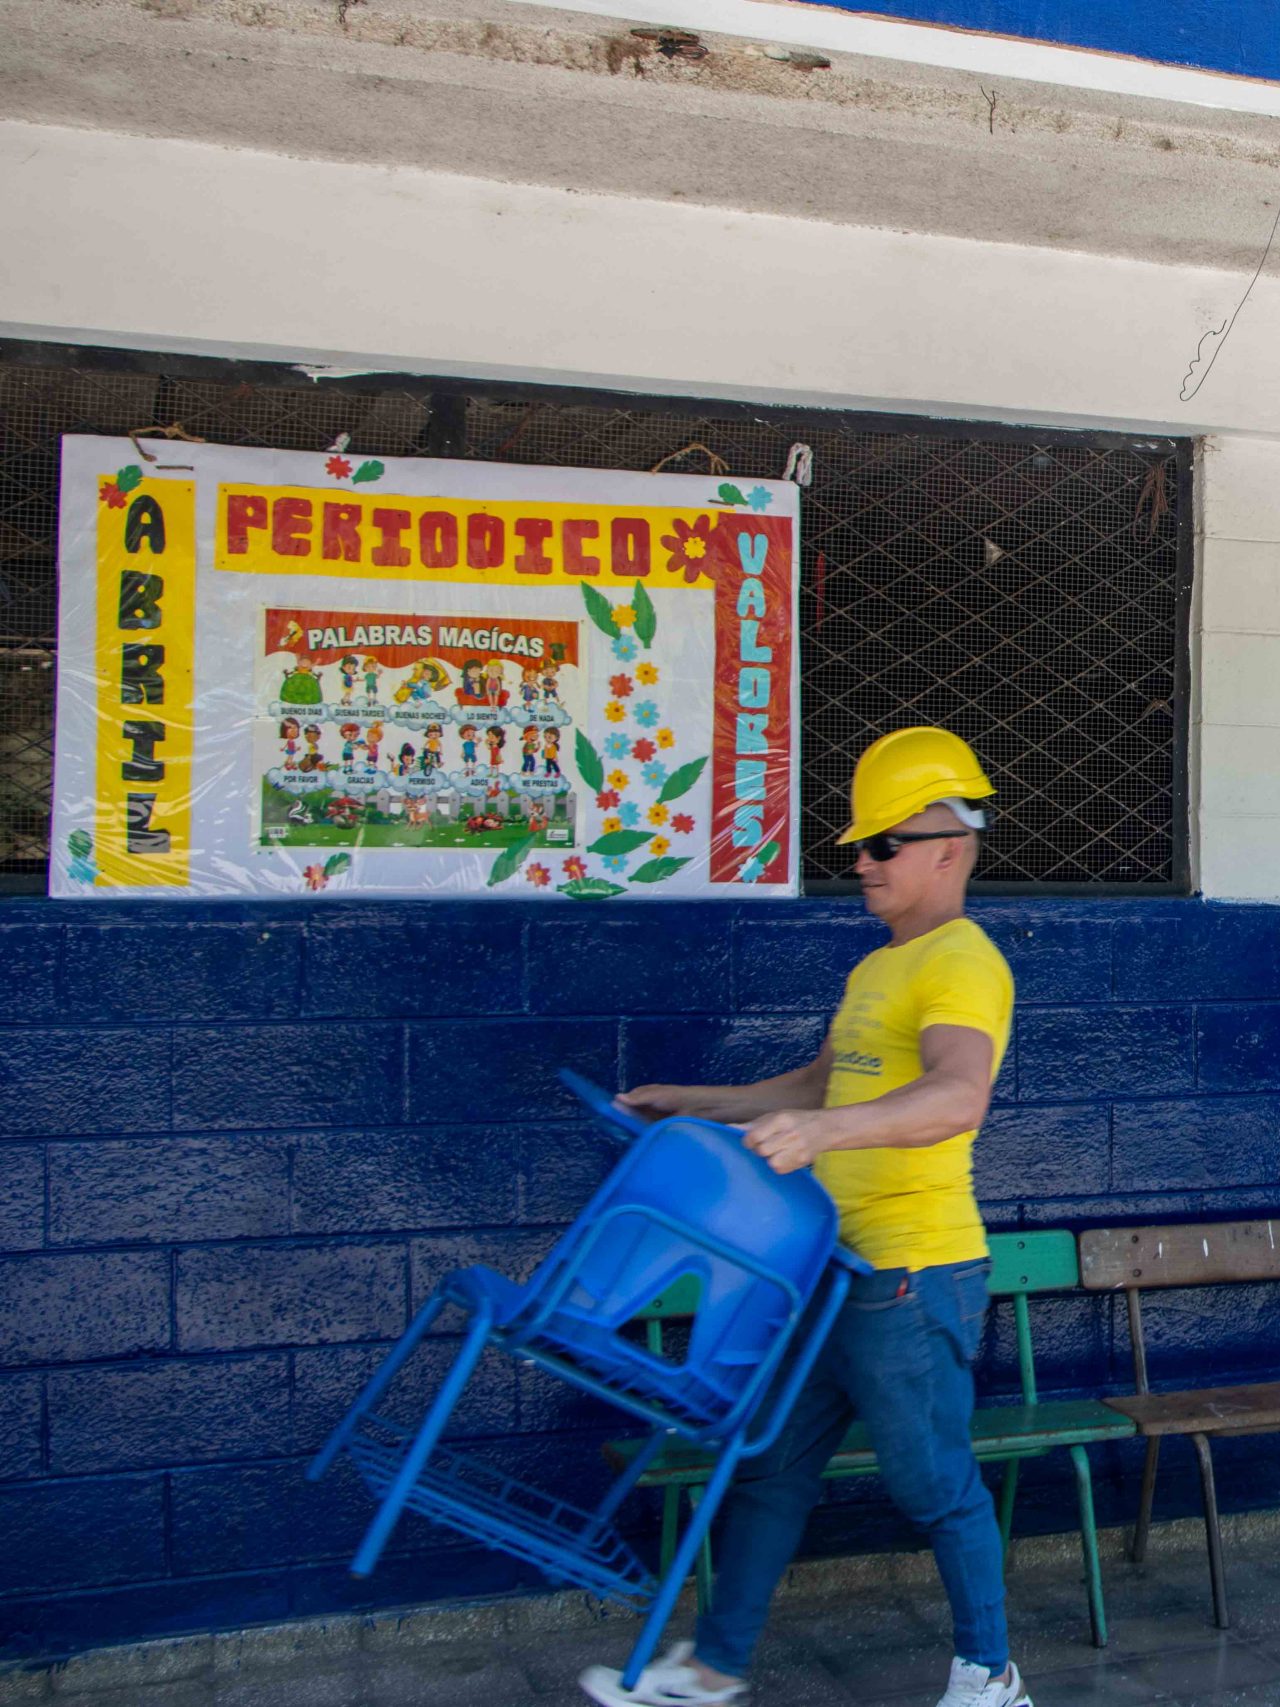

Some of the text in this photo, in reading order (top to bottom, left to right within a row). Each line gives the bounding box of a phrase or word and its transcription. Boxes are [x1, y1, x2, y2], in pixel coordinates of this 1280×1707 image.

[227, 494, 651, 577] PERIODICO
[308, 625, 545, 658] PALABRAS MAGÍCAS
[117, 494, 171, 854] ABRIL
[732, 532, 772, 848] VALORES
[335, 709, 385, 717] BUENAS TARDES
[284, 775, 318, 783] POR FAVOR
[347, 776, 374, 784] GRACIAS
[408, 777, 435, 785] PERMISO
[522, 779, 531, 787] ME
